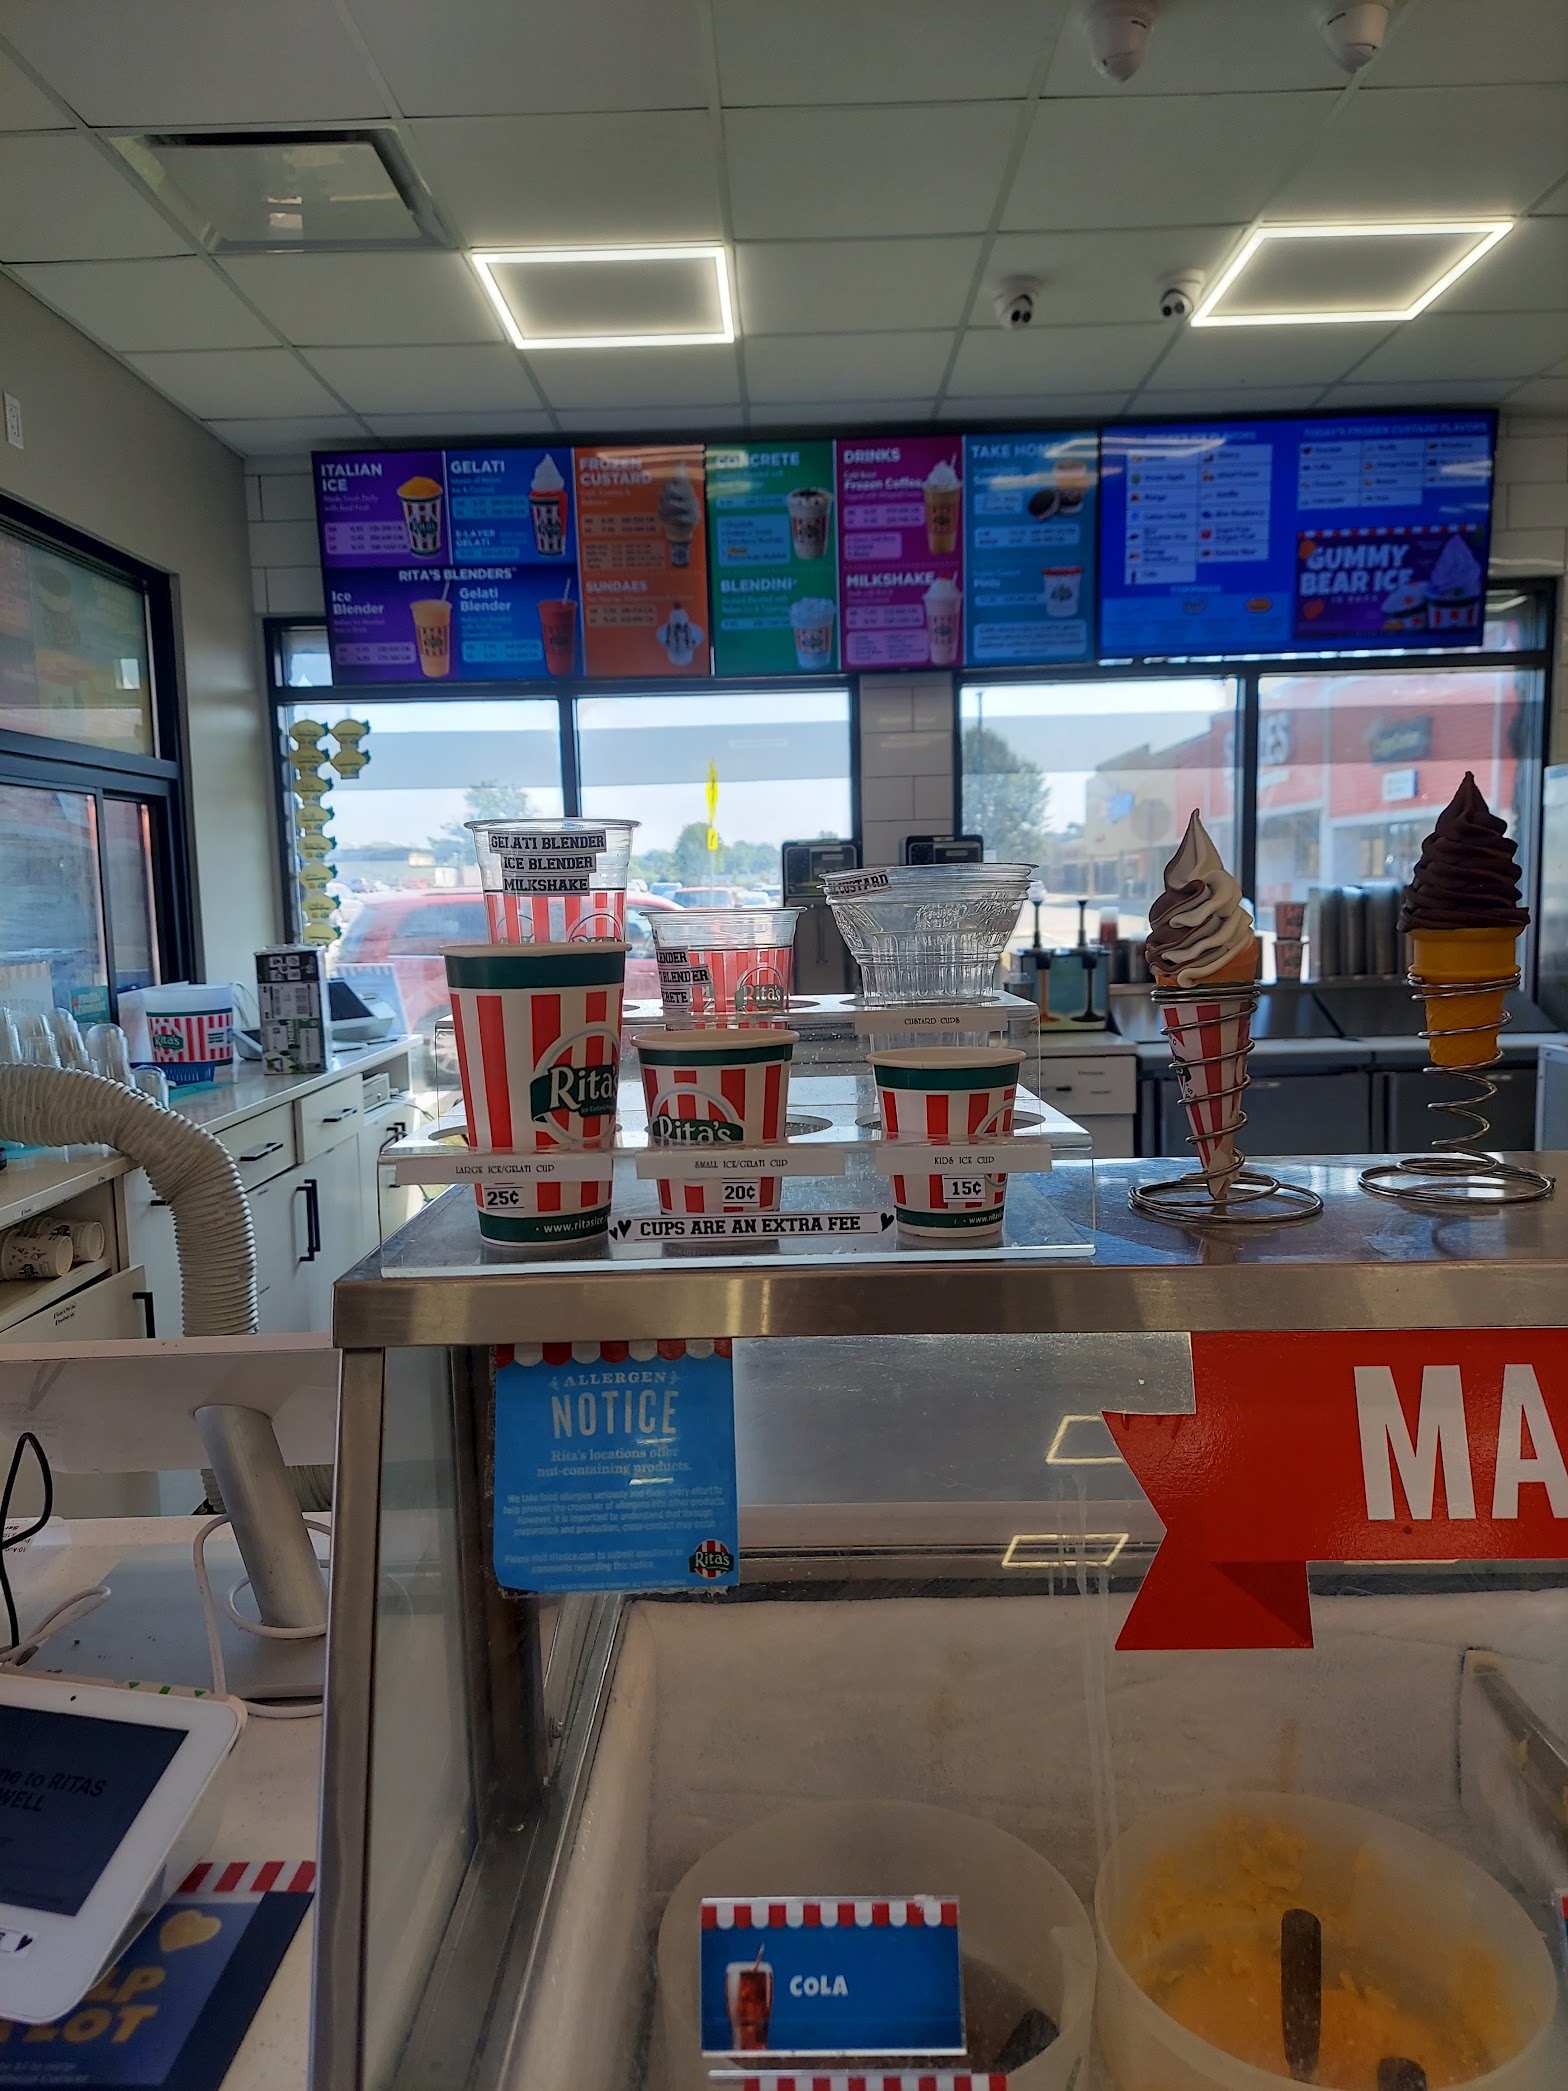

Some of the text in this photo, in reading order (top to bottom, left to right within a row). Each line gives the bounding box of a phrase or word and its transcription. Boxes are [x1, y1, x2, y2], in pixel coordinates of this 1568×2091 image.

[971, 444, 1011, 458] TAKE
[321, 463, 382, 476] ITALIAN
[451, 460, 506, 474] GELATI
[322, 479, 348, 492] ICE
[1306, 544, 1410, 570] GUMMY
[398, 567, 513, 582] RITA'S BLENDERS
[1300, 566, 1414, 597] BEAR ICE
[459, 586, 498, 600] Gelati
[587, 580, 648, 593] SUNDAES
[332, 590, 352, 602] Ice
[333, 602, 385, 615] Blender
[460, 600, 512, 613] Blender
[491, 834, 605, 850] GELATI BLENDER
[504, 856, 594, 870] ICE BLENDER
[503, 878, 588, 892] MILKSHAKE
[746, 984, 782, 1002] Rita's
[904, 1016, 961, 1026] CUSTARD CUPS
[154, 1033, 181, 1047] Rita's
[658, 1114, 732, 1146] Rita's
[694, 1158, 788, 1168] SMALL ICE/GELATI CUP
[934, 1156, 994, 1164] KIDS ICE CUP
[456, 1164, 555, 1174] LARGE ICE/GELATI CUP
[724, 1186, 756, 1200] 20¢
[952, 1181, 982, 1196] 15¢
[487, 1190, 520, 1206] 25¢
[640, 1216, 861, 1236] CUPS ARE AN EXTRA FEE
[564, 1371, 666, 1388] ALLERGEN
[552, 1390, 680, 1440] NOTICE
[1354, 1364, 1568, 1520] MA
[550, 1446, 680, 1462] Rita's locations offer
[536, 1461, 692, 1478] nut-containing products.
[694, 1552, 731, 1568] Rita's
[24, 1770, 44, 1788] to
[48, 1774, 107, 1797] RITAS
[790, 1975, 848, 1998] COLA
